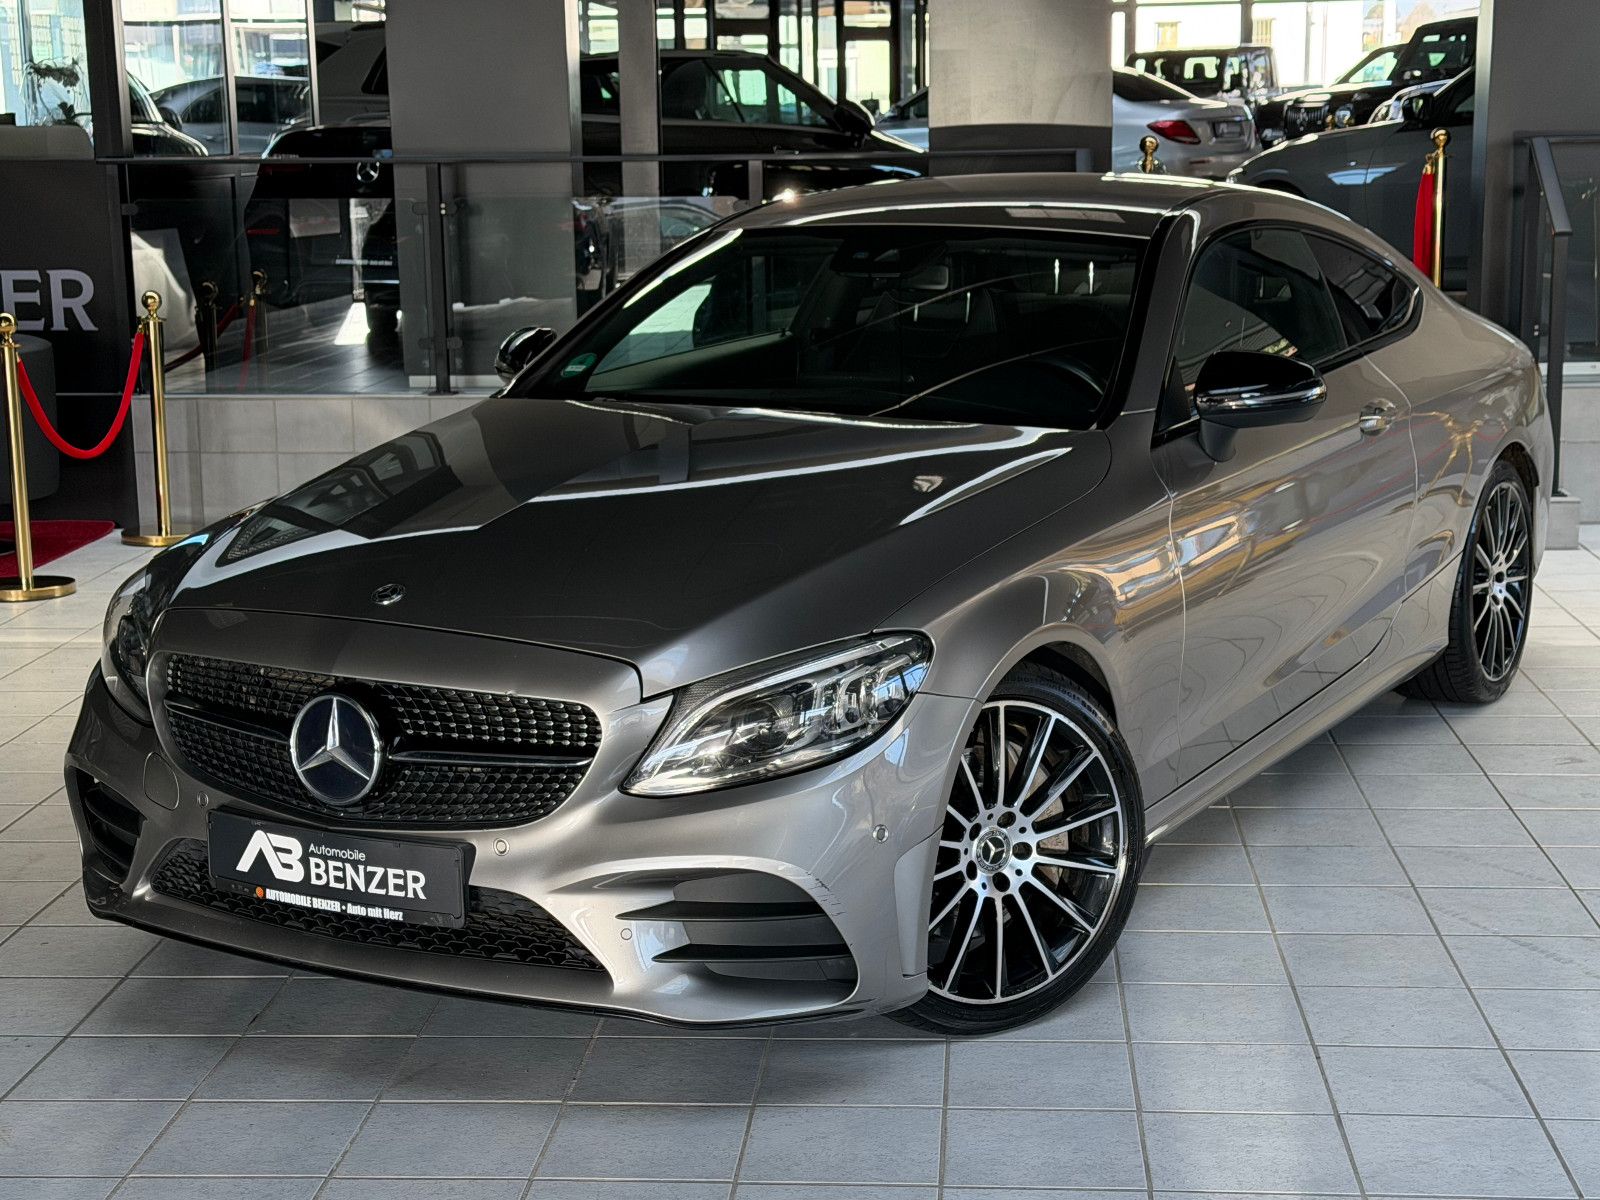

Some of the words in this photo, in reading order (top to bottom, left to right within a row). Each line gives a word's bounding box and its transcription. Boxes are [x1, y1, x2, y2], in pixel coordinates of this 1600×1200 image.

[235, 829, 305, 883] AB
[309, 843, 366, 861] Automobile
[308, 857, 427, 900] BENZER
[265, 888, 312, 908] AUTOMOBILE
[312, 896, 341, 913] BENZER
[346, 903, 367, 916] Auto
[367, 907, 383, 919] mit
[383, 908, 404, 921] Herz
